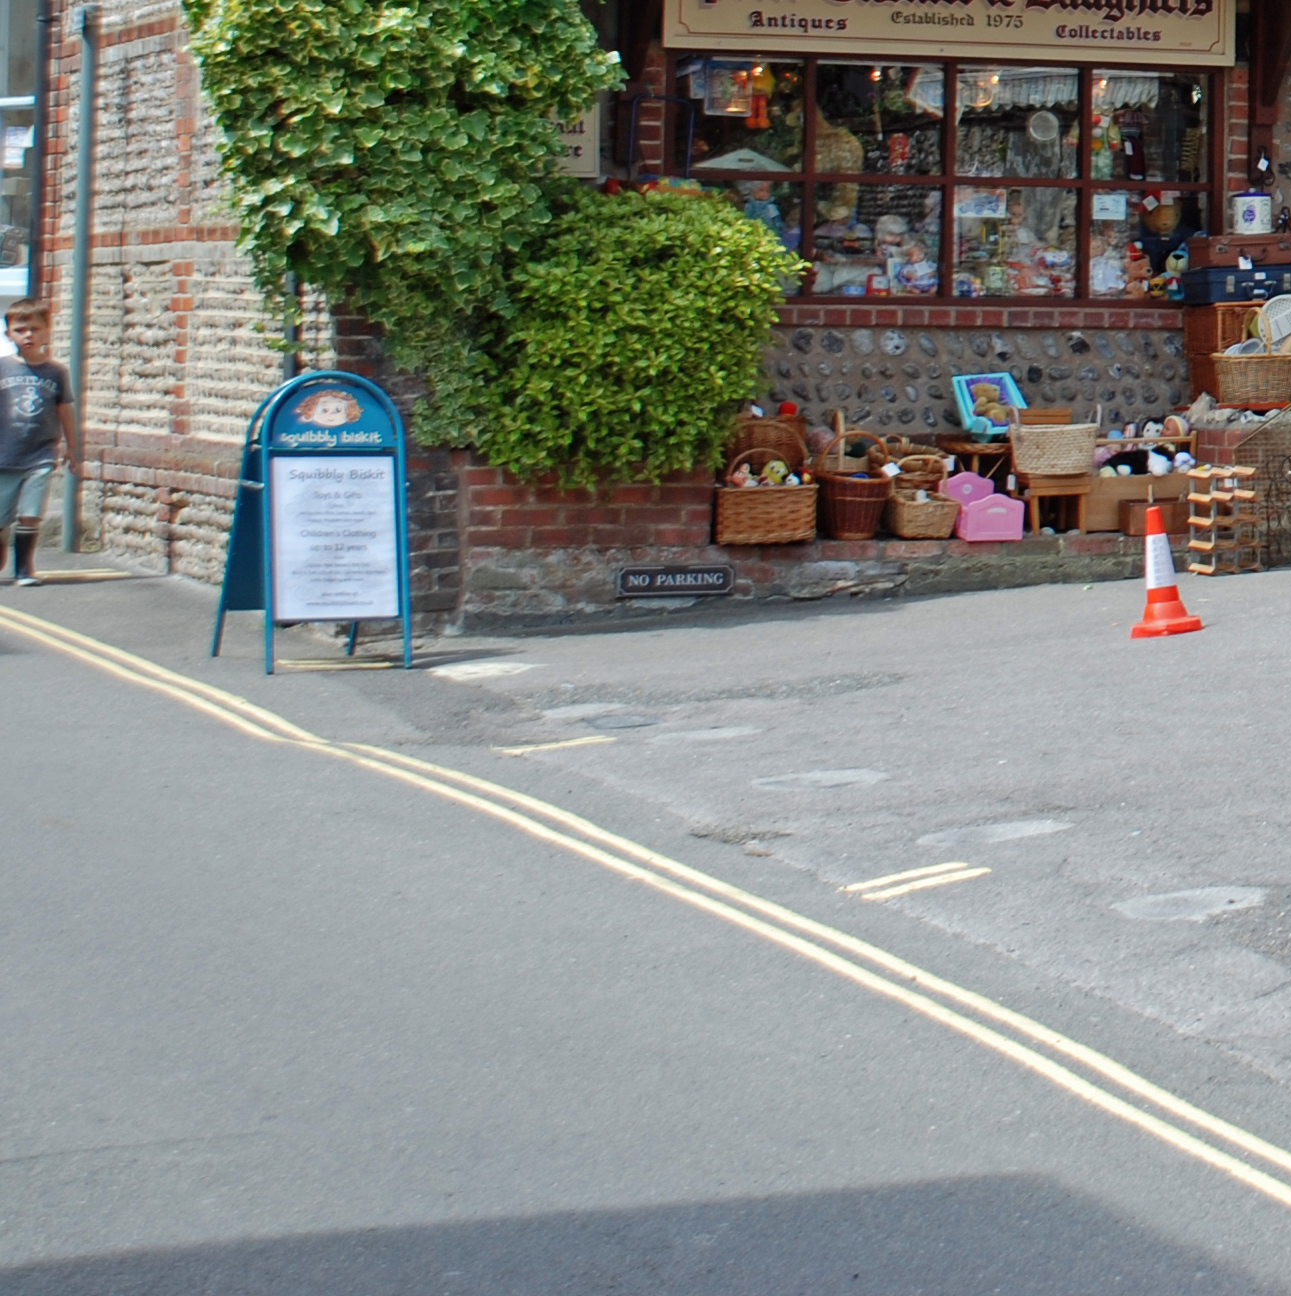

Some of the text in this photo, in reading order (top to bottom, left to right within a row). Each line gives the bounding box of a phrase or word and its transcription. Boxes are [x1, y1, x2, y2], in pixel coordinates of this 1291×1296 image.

[749, 9, 850, 33] Antiques
[890, 10, 1024, 29] Established 1975
[1055, 22, 1163, 43] Collectables
[280, 429, 383, 448] squibbly biskit
[289, 467, 387, 483] Squibbly Biskit
[628, 572, 724, 586] NO PARKING
